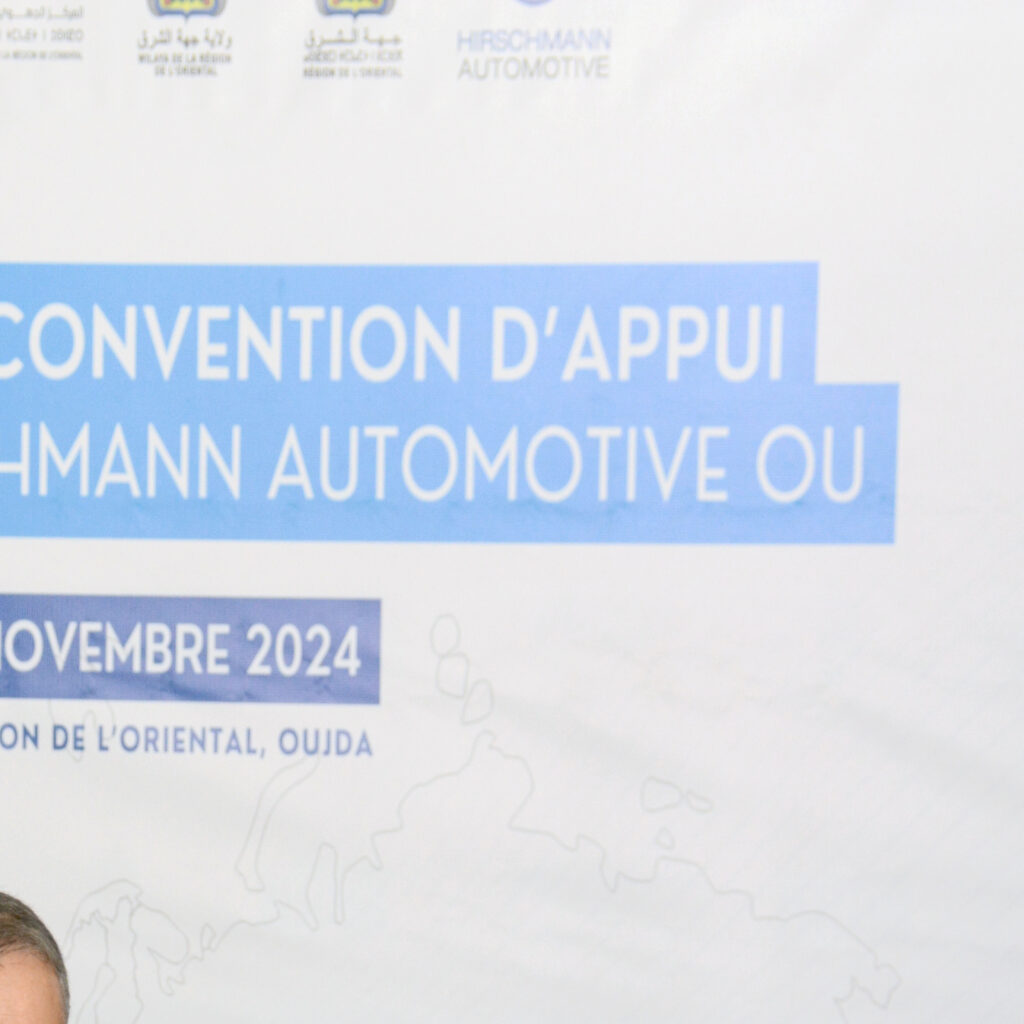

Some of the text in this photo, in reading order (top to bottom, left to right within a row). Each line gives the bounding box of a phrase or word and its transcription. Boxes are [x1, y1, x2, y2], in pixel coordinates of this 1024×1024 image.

[456, 29, 612, 53] HIRSCHMANN
[457, 54, 610, 80] AUTOMOTIVE
[489, 303, 787, 385] D'APPUI
[265, 423, 732, 505] AUTOMOTIVE
[755, 423, 866, 505] OU
[246, 622, 363, 678] 2024
[52, 724, 86, 752] DE
[98, 725, 270, 758] L'ORIENTAL,
[280, 728, 372, 757] OUJDA
